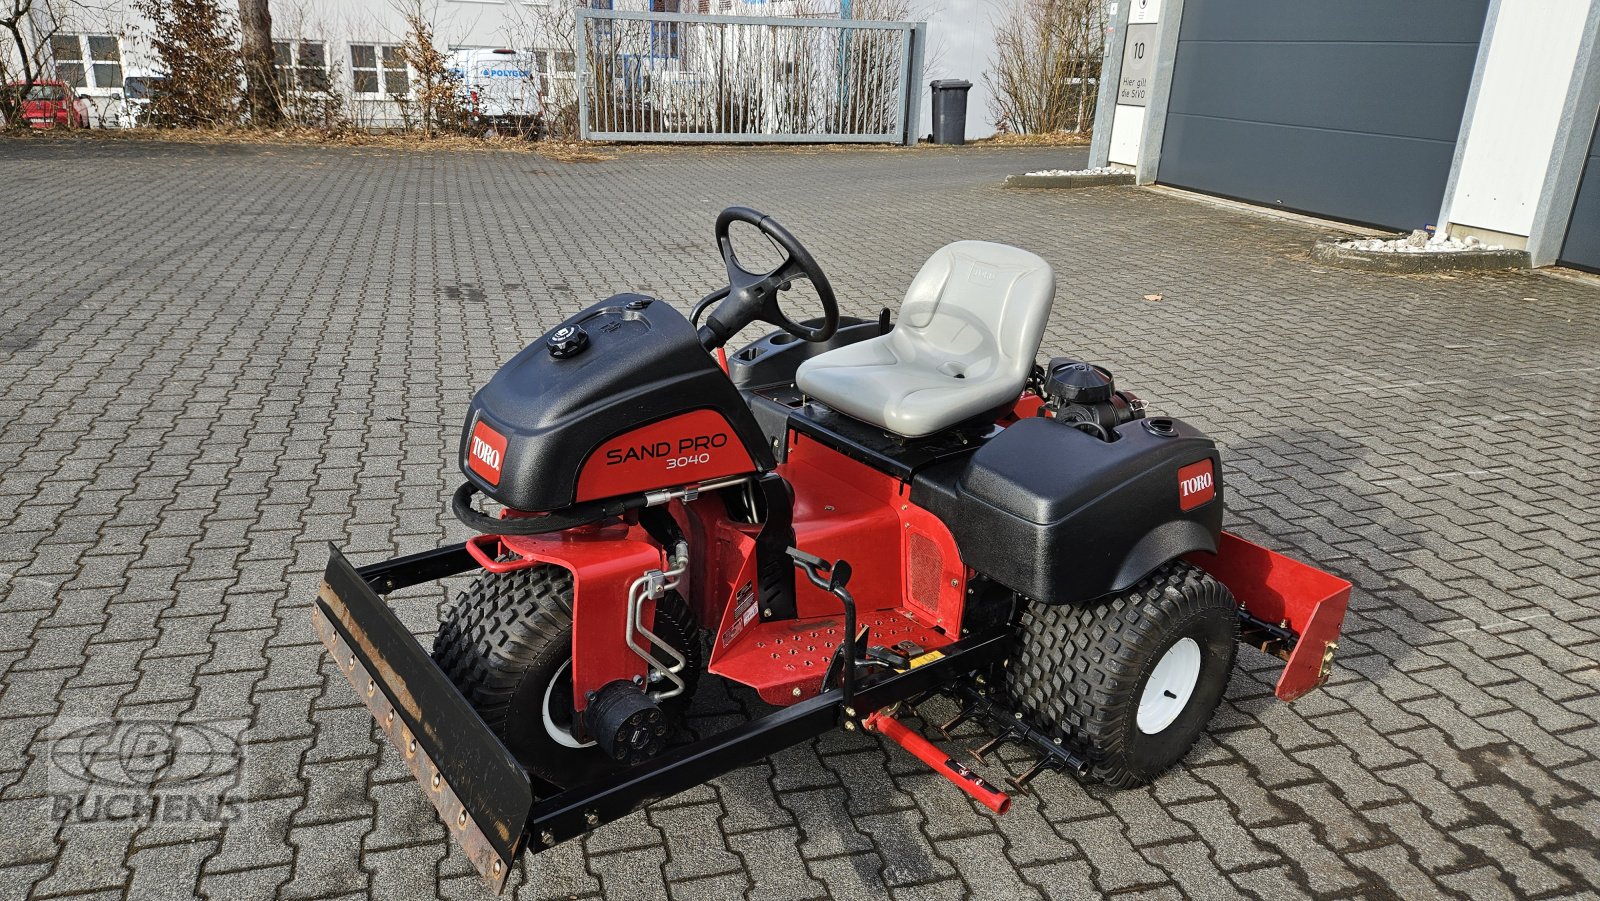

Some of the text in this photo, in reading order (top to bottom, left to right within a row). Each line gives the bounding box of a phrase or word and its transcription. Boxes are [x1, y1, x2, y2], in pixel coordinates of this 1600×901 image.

[1134, 42, 1145, 59] 10
[1123, 77, 1135, 86] Hier
[1121, 89, 1145, 98] die StVO
[473, 435, 500, 469] TORO
[606, 433, 728, 466] SAND PRO
[666, 453, 710, 470] 3040
[1181, 472, 1211, 496] TORO
